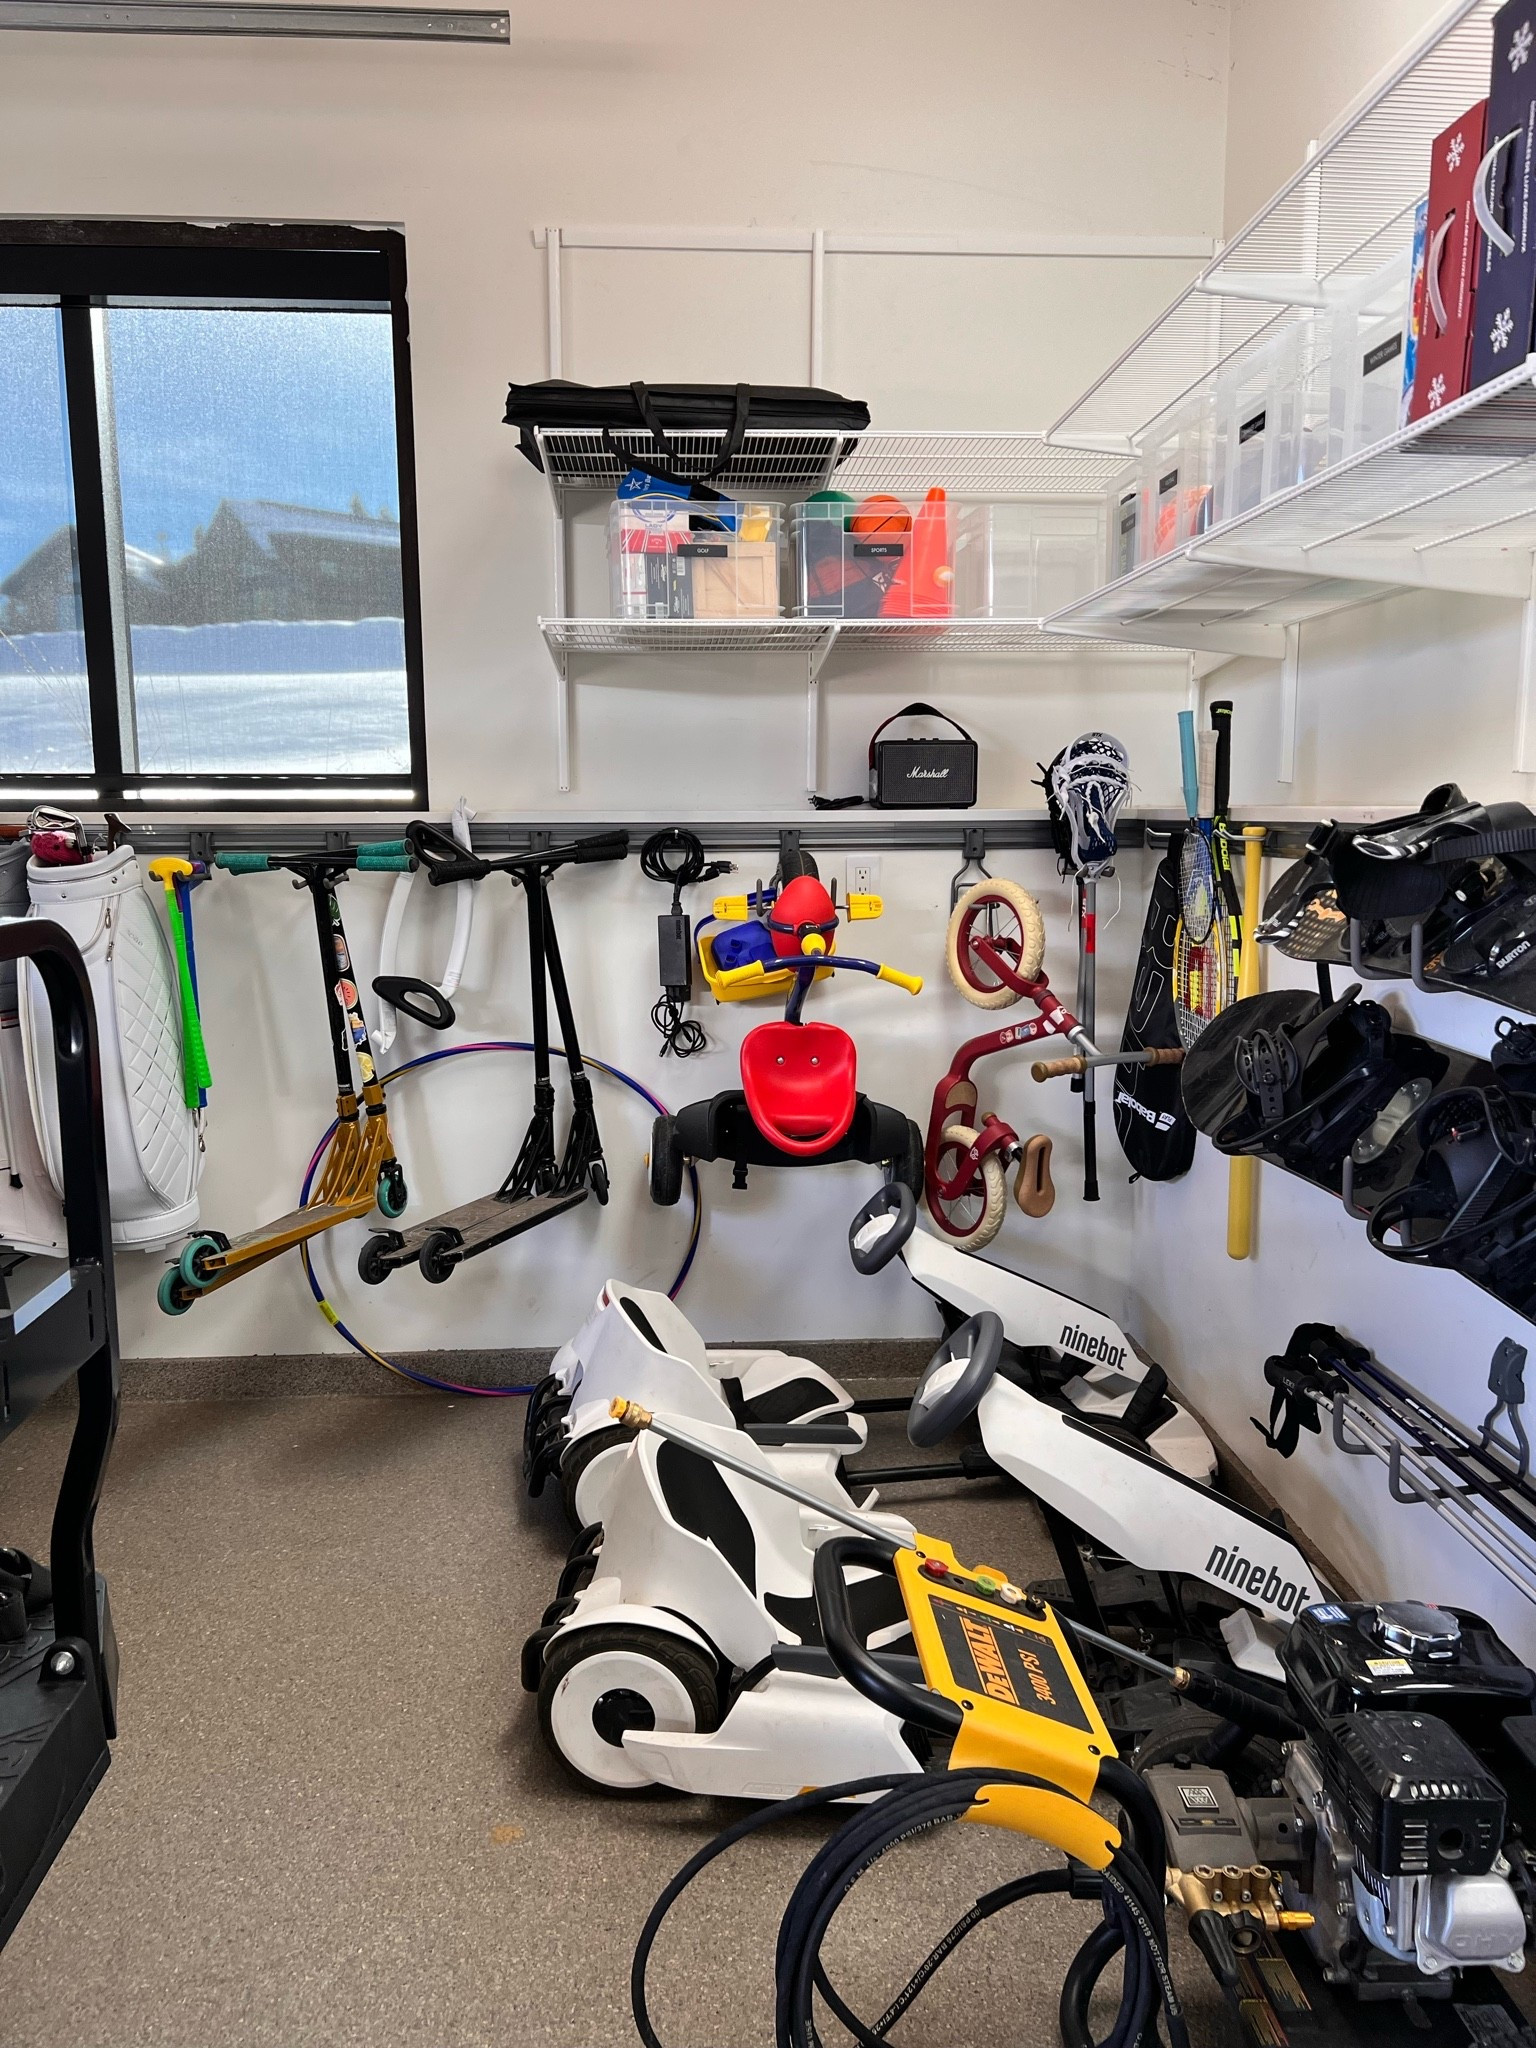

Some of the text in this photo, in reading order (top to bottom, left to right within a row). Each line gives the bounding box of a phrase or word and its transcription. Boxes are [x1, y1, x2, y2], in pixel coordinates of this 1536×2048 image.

[906, 765, 950, 779] Marshall
[1218, 822, 1231, 871] Bbolat
[1495, 940, 1531, 969] BURTON
[1114, 1091, 1157, 1124] Babolat
[1059, 1324, 1128, 1371] ninebot
[1282, 1376, 1295, 1389] LEKI
[1205, 1545, 1311, 1617] ninebot
[963, 1617, 1016, 1705] DEWALT
[1018, 1648, 1057, 1706] 3400 PSI
[1123, 1894, 1141, 1917] 41145
[1147, 1938, 1159, 1957] NOT
[1156, 1957, 1167, 1975] FOR
[1161, 1974, 1177, 2003] STEAM
[804, 2020, 814, 2039] USE
